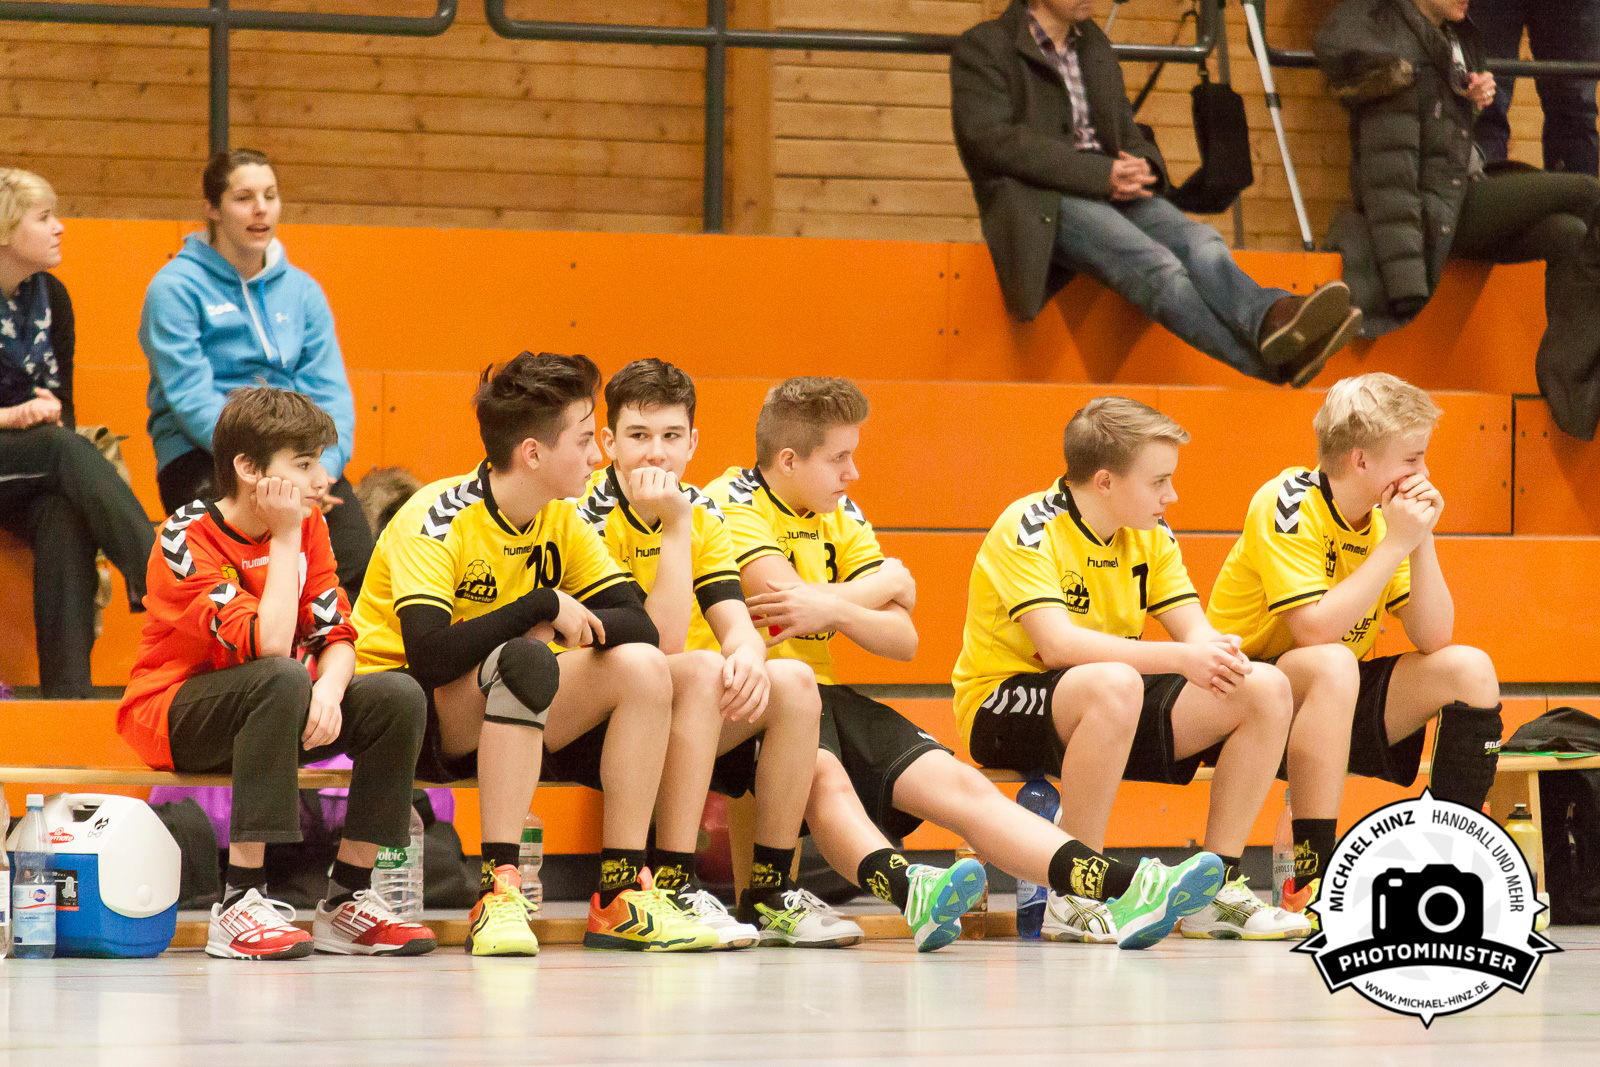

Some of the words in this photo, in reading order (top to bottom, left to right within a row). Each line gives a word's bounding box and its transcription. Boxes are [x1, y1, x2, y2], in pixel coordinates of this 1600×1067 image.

[503, 542, 534, 556] hummel
[635, 546, 661, 558] humm
[1341, 542, 1369, 556] ummel
[241, 555, 270, 570] humm
[526, 541, 562, 590] 10
[458, 581, 497, 598] ART
[1066, 593, 1090, 607] RT
[378, 848, 405, 861] olvic
